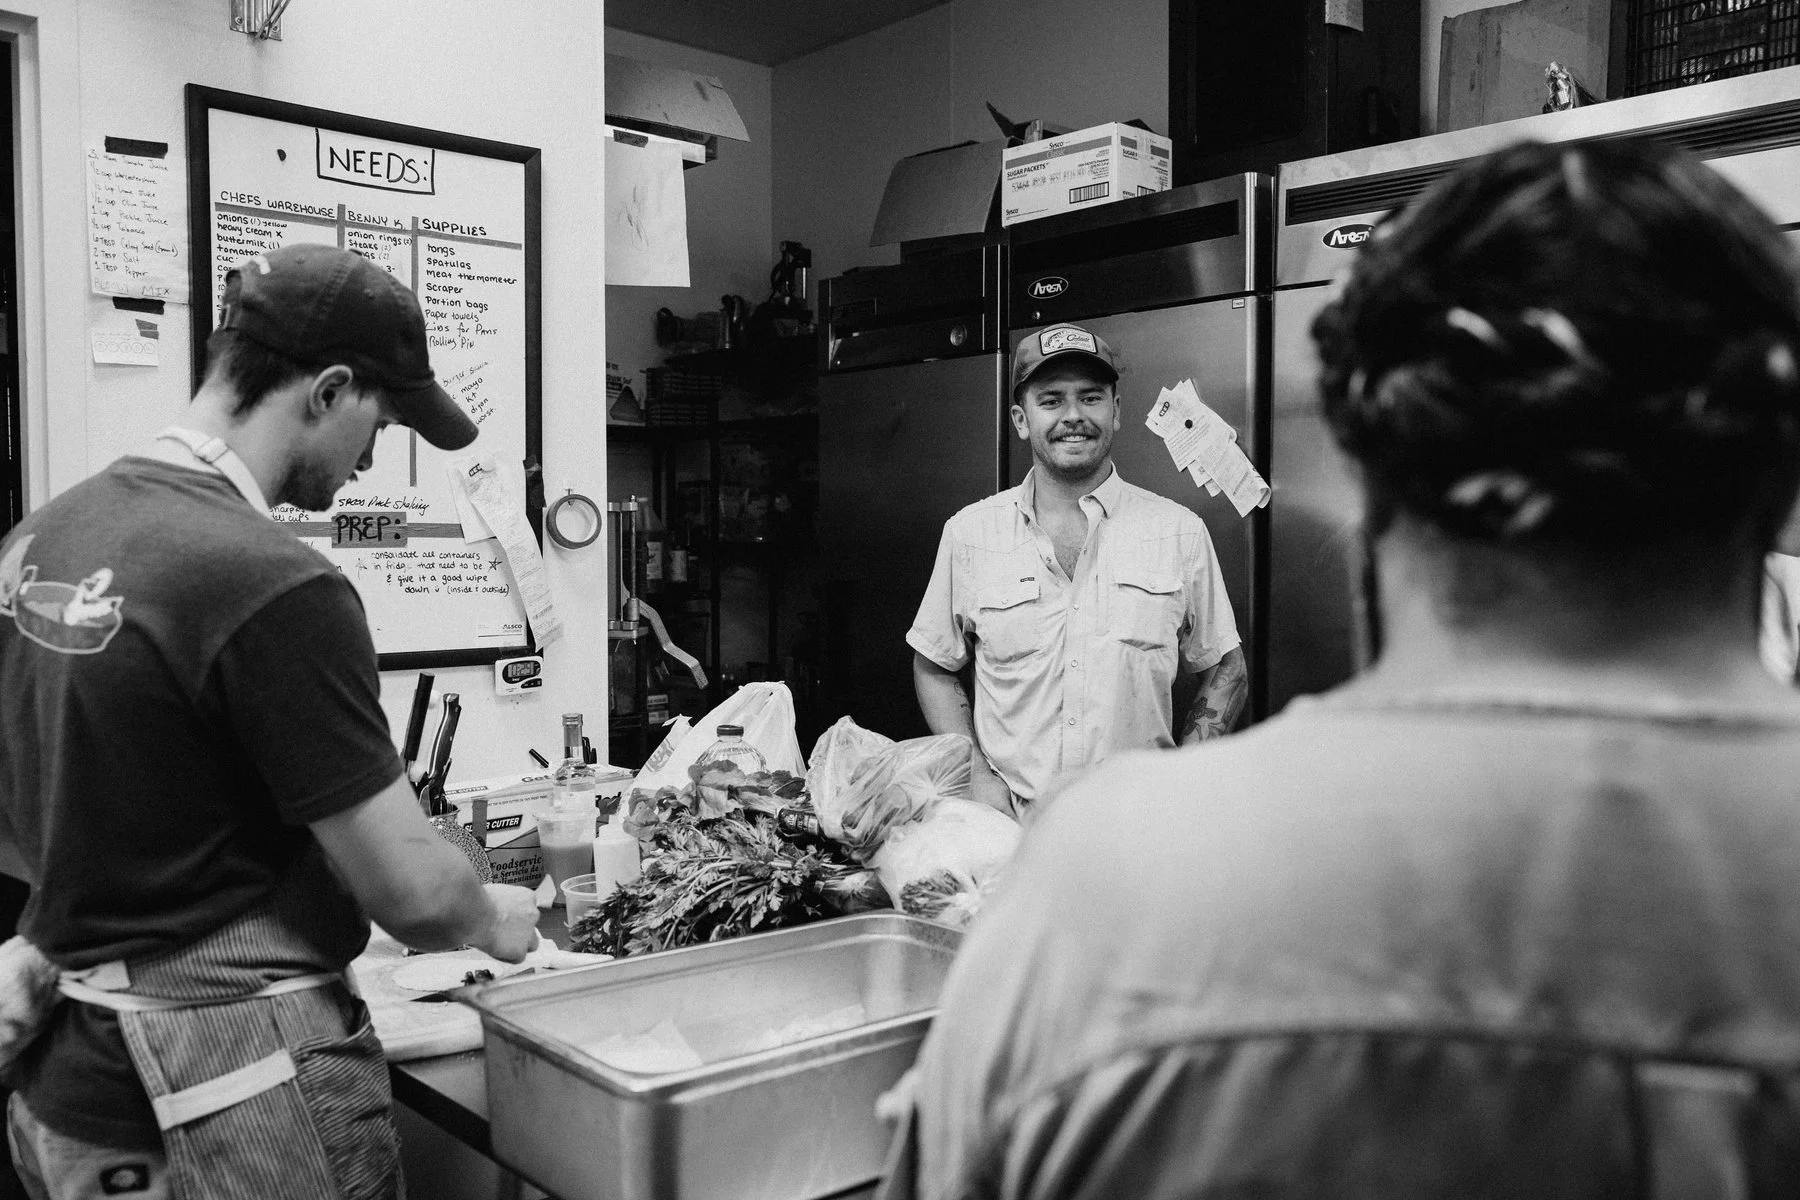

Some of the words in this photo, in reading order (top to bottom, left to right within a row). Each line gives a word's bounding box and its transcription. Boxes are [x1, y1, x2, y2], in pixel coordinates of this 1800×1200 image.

[1049, 141, 1064, 150] Sysco
[329, 146, 428, 184] NEEDS:
[1007, 168, 1024, 178] SUGAR
[1023, 163, 1046, 174] PACKETS
[220, 190, 262, 206] CHEFS
[267, 199, 336, 219] WAREHOUSE
[216, 213, 249, 225] onions
[347, 210, 388, 226] BENNY
[216, 222, 243, 236] heavy
[246, 226, 272, 238] cream
[422, 218, 487, 236] SUPPLIES
[216, 232, 267, 249] buttermilk
[347, 230, 376, 240] onion
[379, 234, 402, 247] rings
[426, 269, 452, 279] meat
[457, 272, 518, 285] thermometer
[465, 299, 489, 313] bags
[451, 312, 480, 323] towels
[460, 377, 483, 394] mayo
[288, 512, 310, 523] cups
[334, 514, 402, 545] PREP:
[422, 550, 436, 558] all
[438, 551, 481, 561] containers
[472, 562, 483, 571] be
[397, 574, 414, 587] give
[441, 574, 463, 586] good
[465, 574, 488, 583] wipe
[404, 586, 430, 594] down
[464, 822, 490, 832] SLR
[491, 817, 520, 829] CUTTER
